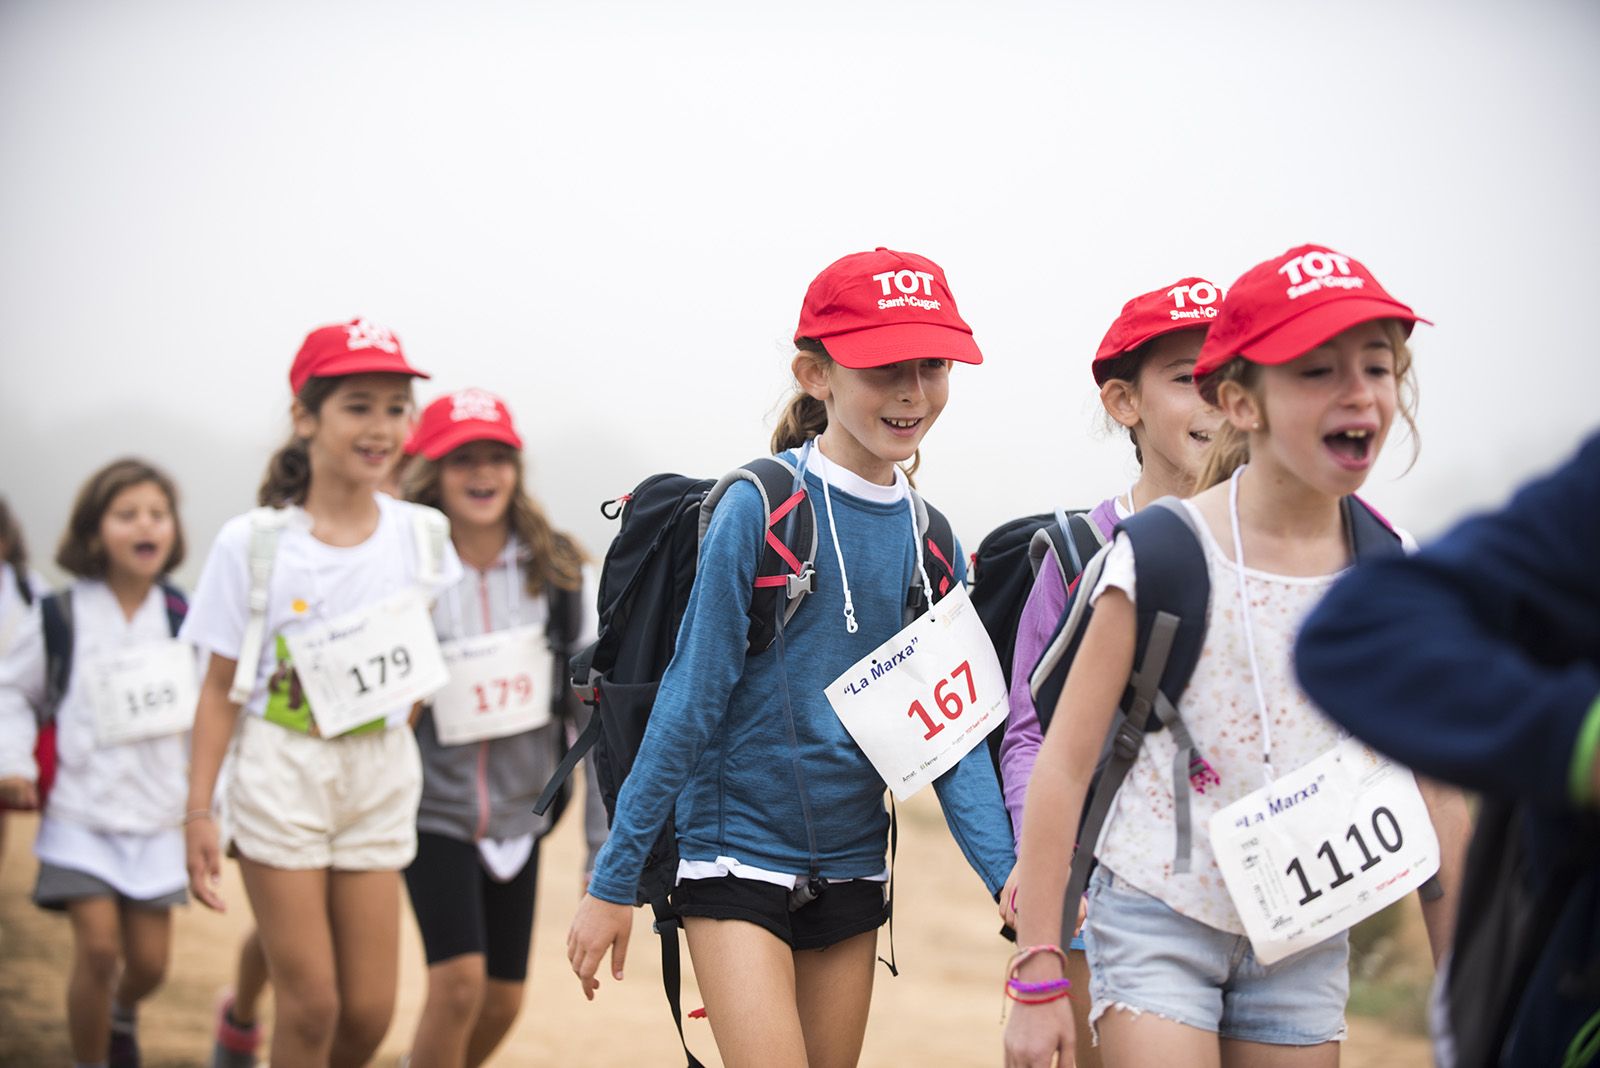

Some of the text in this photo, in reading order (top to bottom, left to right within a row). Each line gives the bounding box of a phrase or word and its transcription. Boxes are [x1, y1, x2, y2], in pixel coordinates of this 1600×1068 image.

[872, 269, 934, 296] TOT
[1277, 251, 1352, 284] TOT
[877, 296, 941, 310] Sant Cugat
[1169, 308, 1200, 320] Sant
[349, 644, 412, 696] 179
[473, 673, 533, 715] 179
[907, 660, 978, 741] 167
[1286, 806, 1404, 906] 1110
